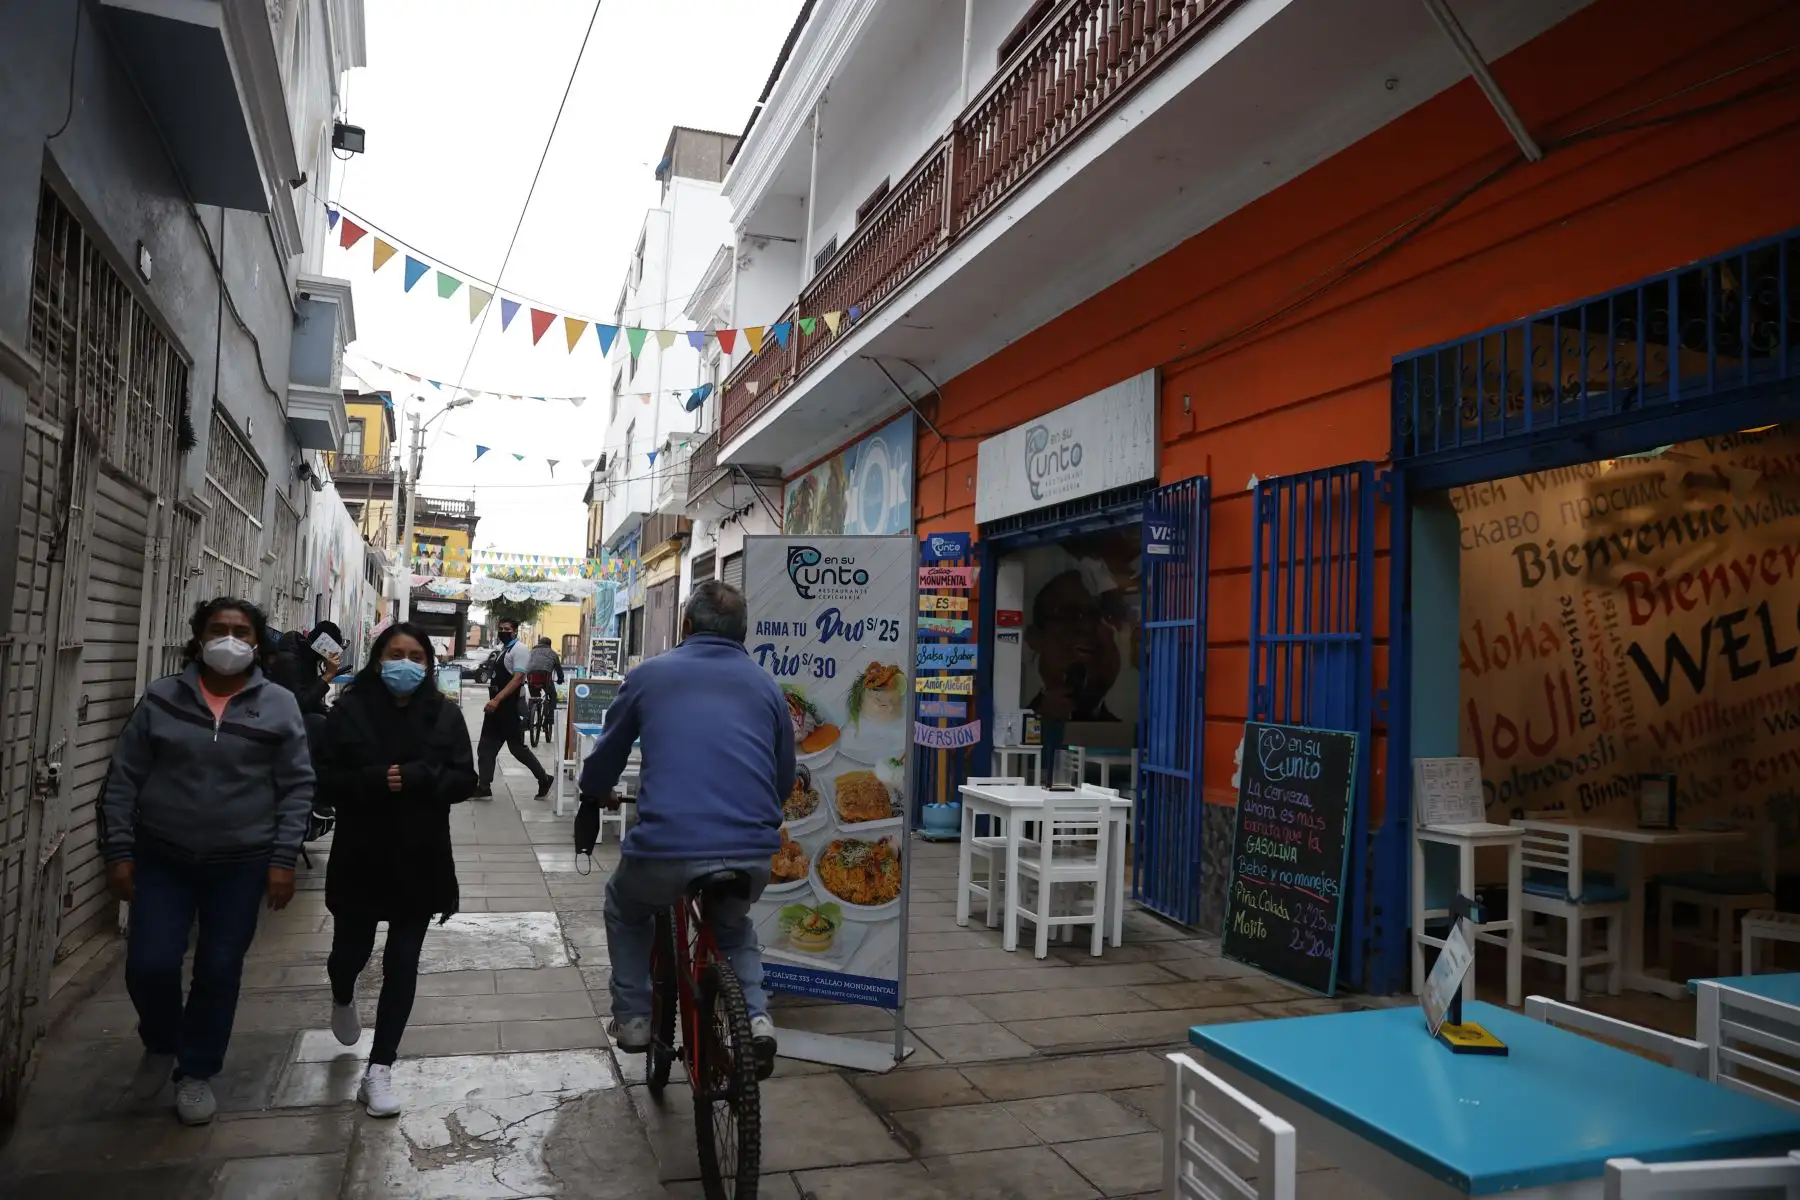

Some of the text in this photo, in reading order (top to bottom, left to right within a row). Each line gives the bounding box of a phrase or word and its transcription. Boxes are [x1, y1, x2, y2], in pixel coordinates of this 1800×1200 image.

[1050, 428, 1073, 445] en su
[1511, 504, 1730, 588] Bienvenue
[824, 556, 855, 565] en su
[919, 575, 968, 586] MONUMENTAL
[935, 598, 949, 609] ES
[756, 621, 789, 637] ARMA
[792, 622, 807, 637] TU
[815, 607, 865, 644] Duo
[1459, 611, 1561, 677] Aloha
[915, 645, 944, 667] Salsa
[914, 727, 975, 746] IVERSIÓN
[1288, 738, 1321, 758] en su
[1248, 777, 1261, 797] La
[1244, 800, 1276, 820] ahora
[1280, 808, 1295, 824] es
[1244, 815, 1323, 853] barata que la
[1246, 835, 1298, 864] GASOLINA
[1237, 855, 1268, 876] Bebe
[1270, 868, 1277, 881] y
[1280, 871, 1292, 884] no
[1235, 880, 1259, 908] Piña
[1258, 890, 1290, 920] Colada
[1233, 910, 1267, 939] Mojito
[814, 977, 842, 988] CALLAO
[843, 981, 896, 995] MONUMENTAL
